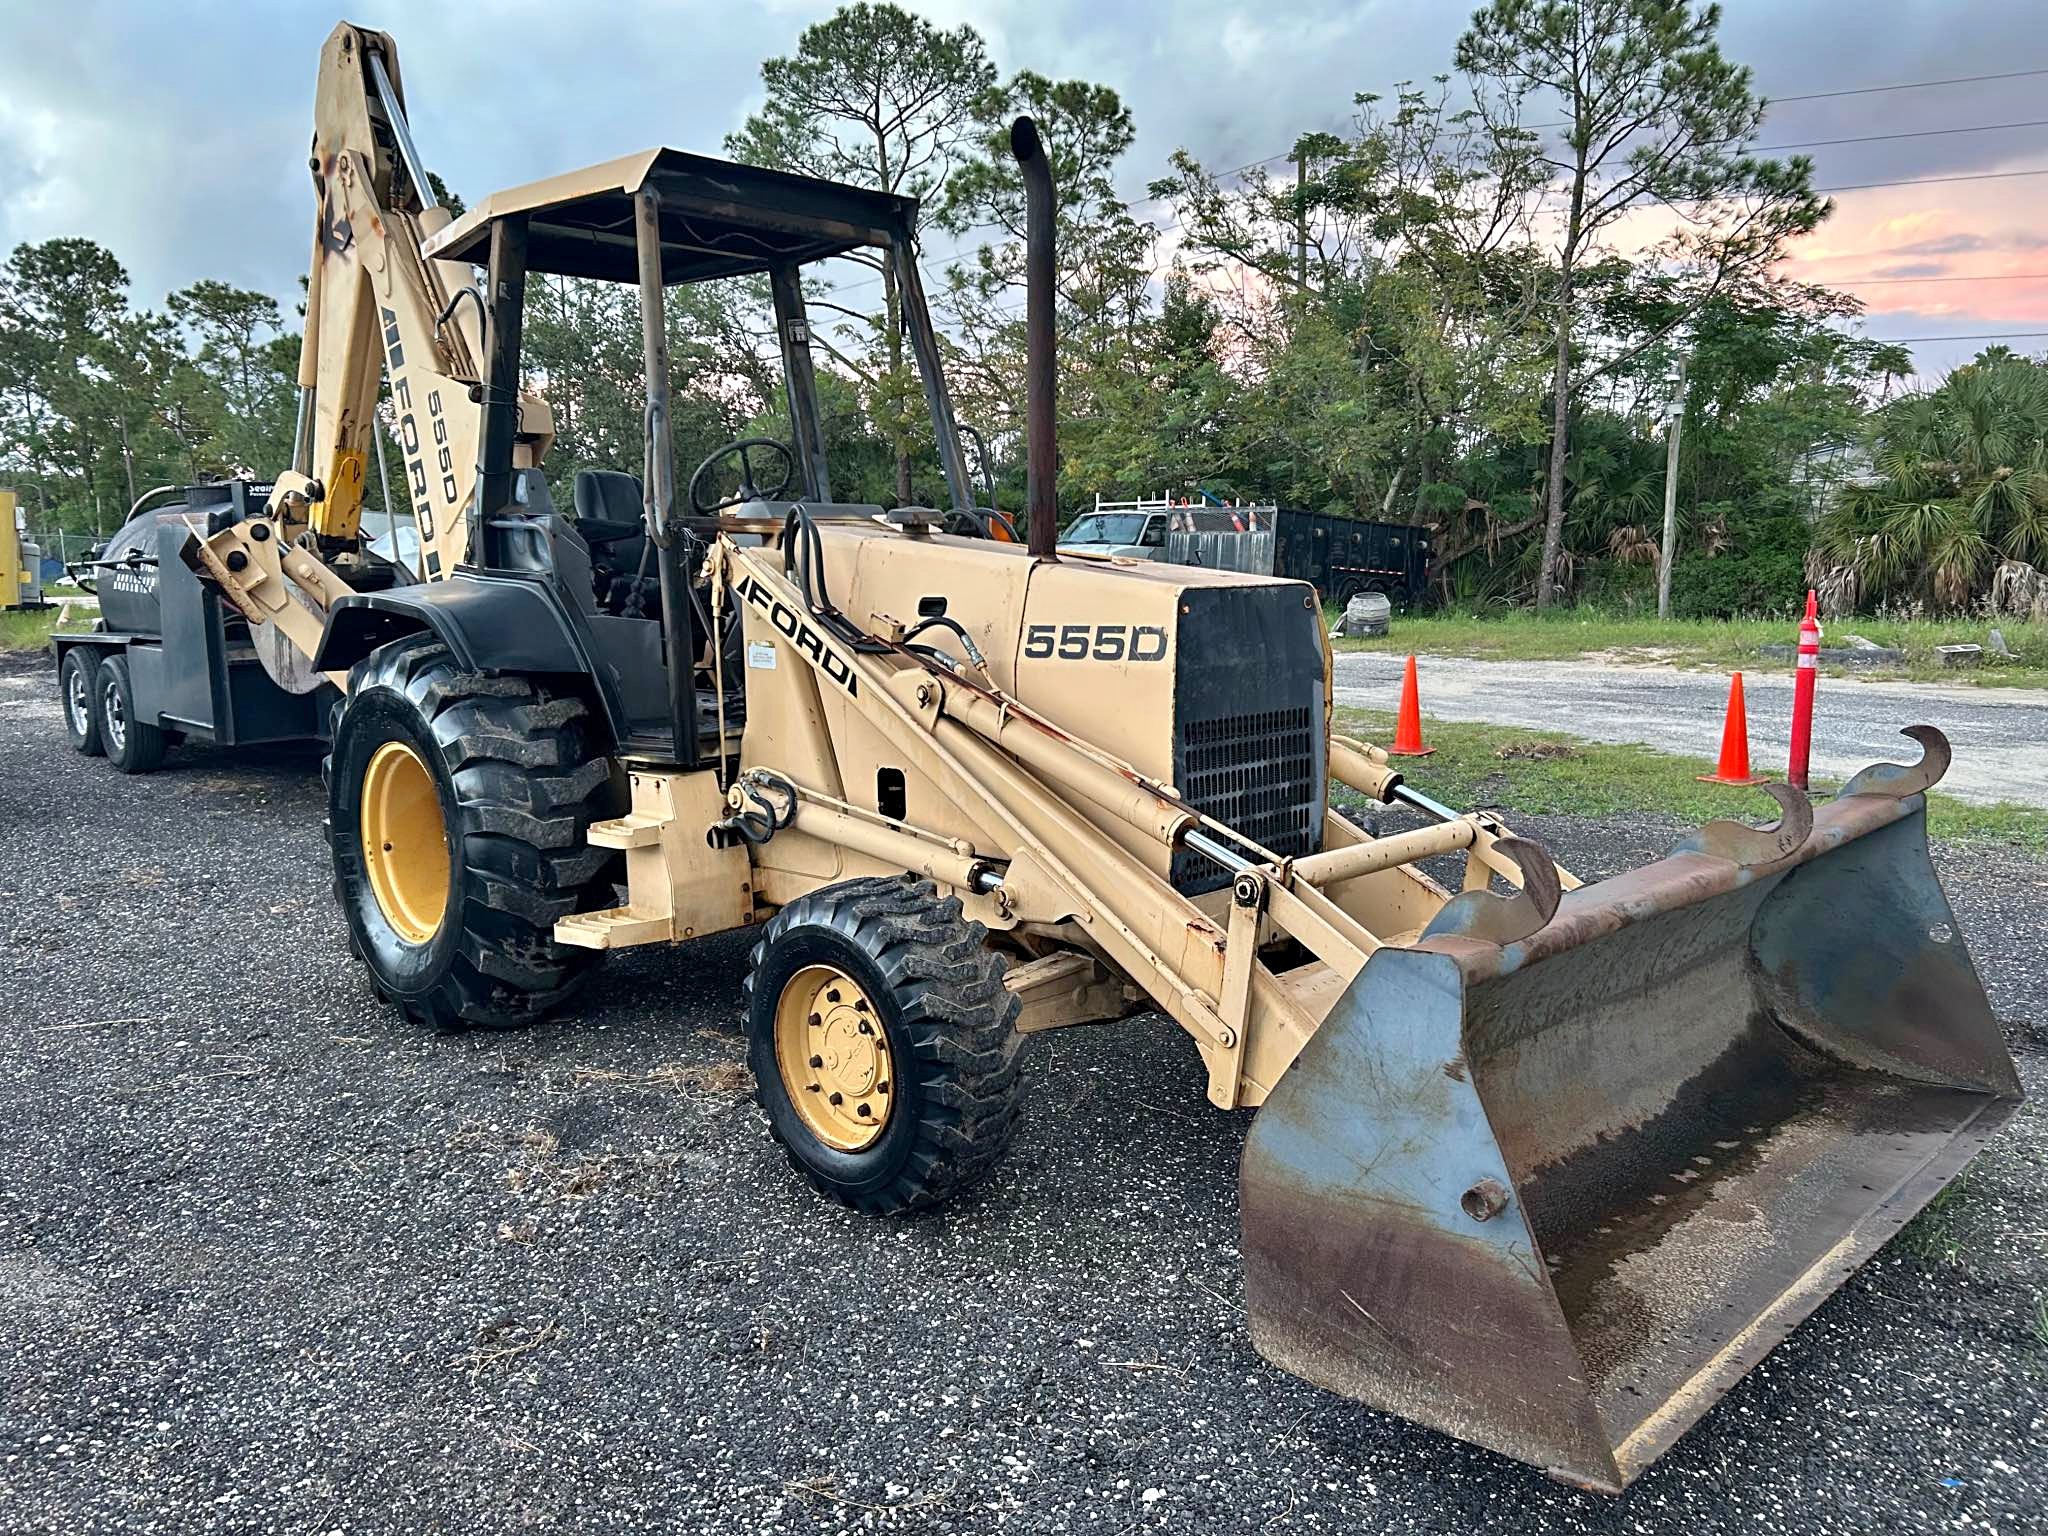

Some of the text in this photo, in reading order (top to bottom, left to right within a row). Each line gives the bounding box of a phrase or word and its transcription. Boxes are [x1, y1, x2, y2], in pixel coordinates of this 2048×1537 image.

[395, 377, 434, 543] FORD
[428, 390, 457, 504] 555D
[747, 579, 850, 685] FORD
[1025, 625, 1168, 661] 555D
